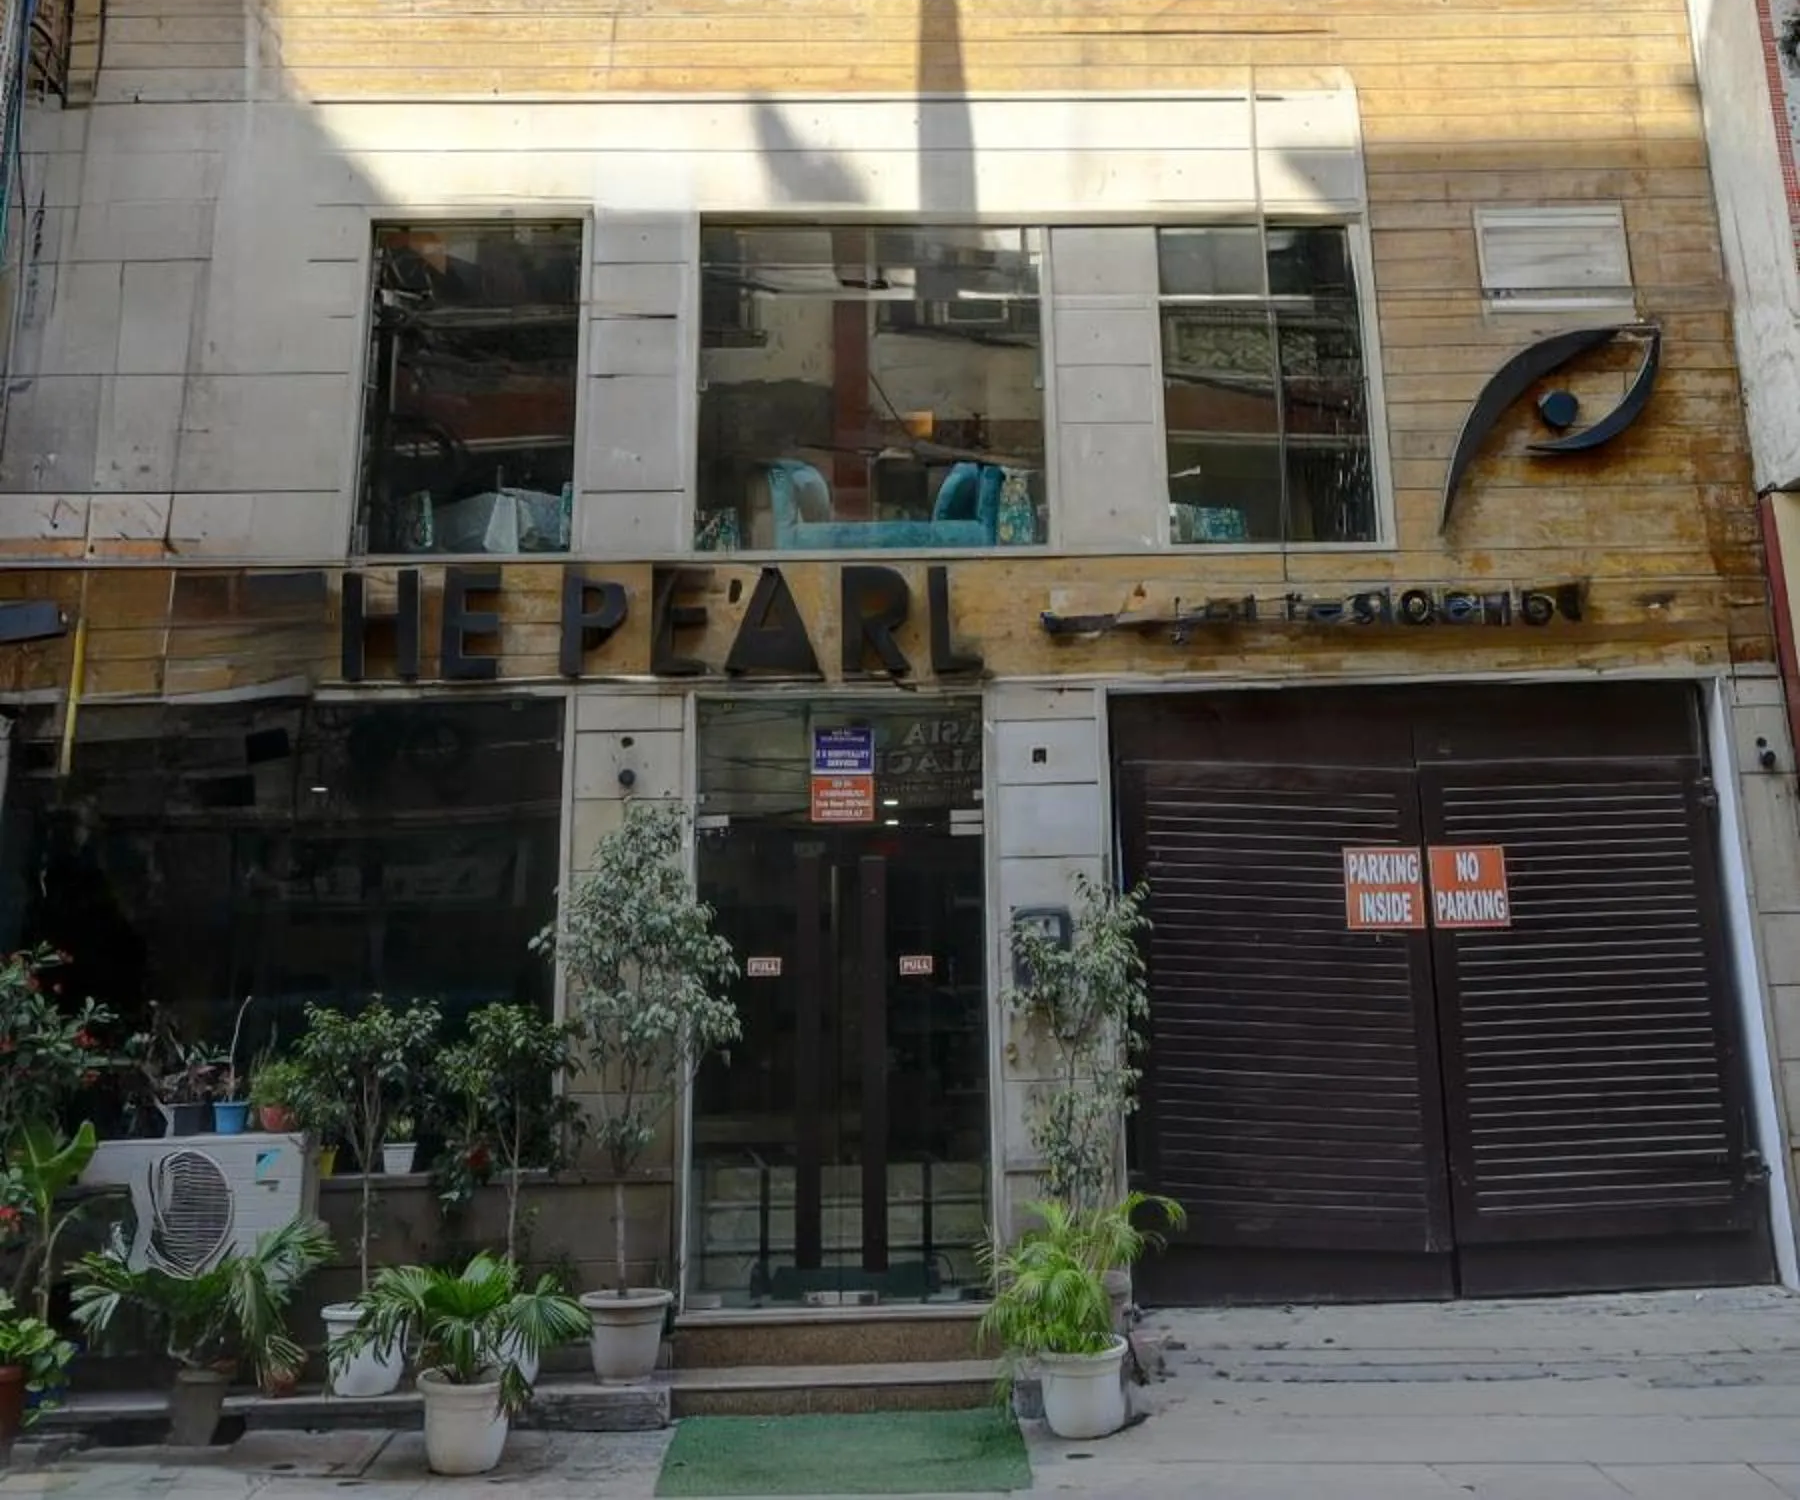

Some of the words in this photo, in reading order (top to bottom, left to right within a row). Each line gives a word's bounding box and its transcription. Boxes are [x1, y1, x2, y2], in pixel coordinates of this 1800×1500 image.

[559, 565, 985, 679] PEARL
[1349, 853, 1418, 884] PARKING
[1455, 851, 1479, 882] NO
[1359, 891, 1413, 923] INSIDE
[1437, 890, 1505, 921] PARKING
[903, 959, 929, 970] PULL
